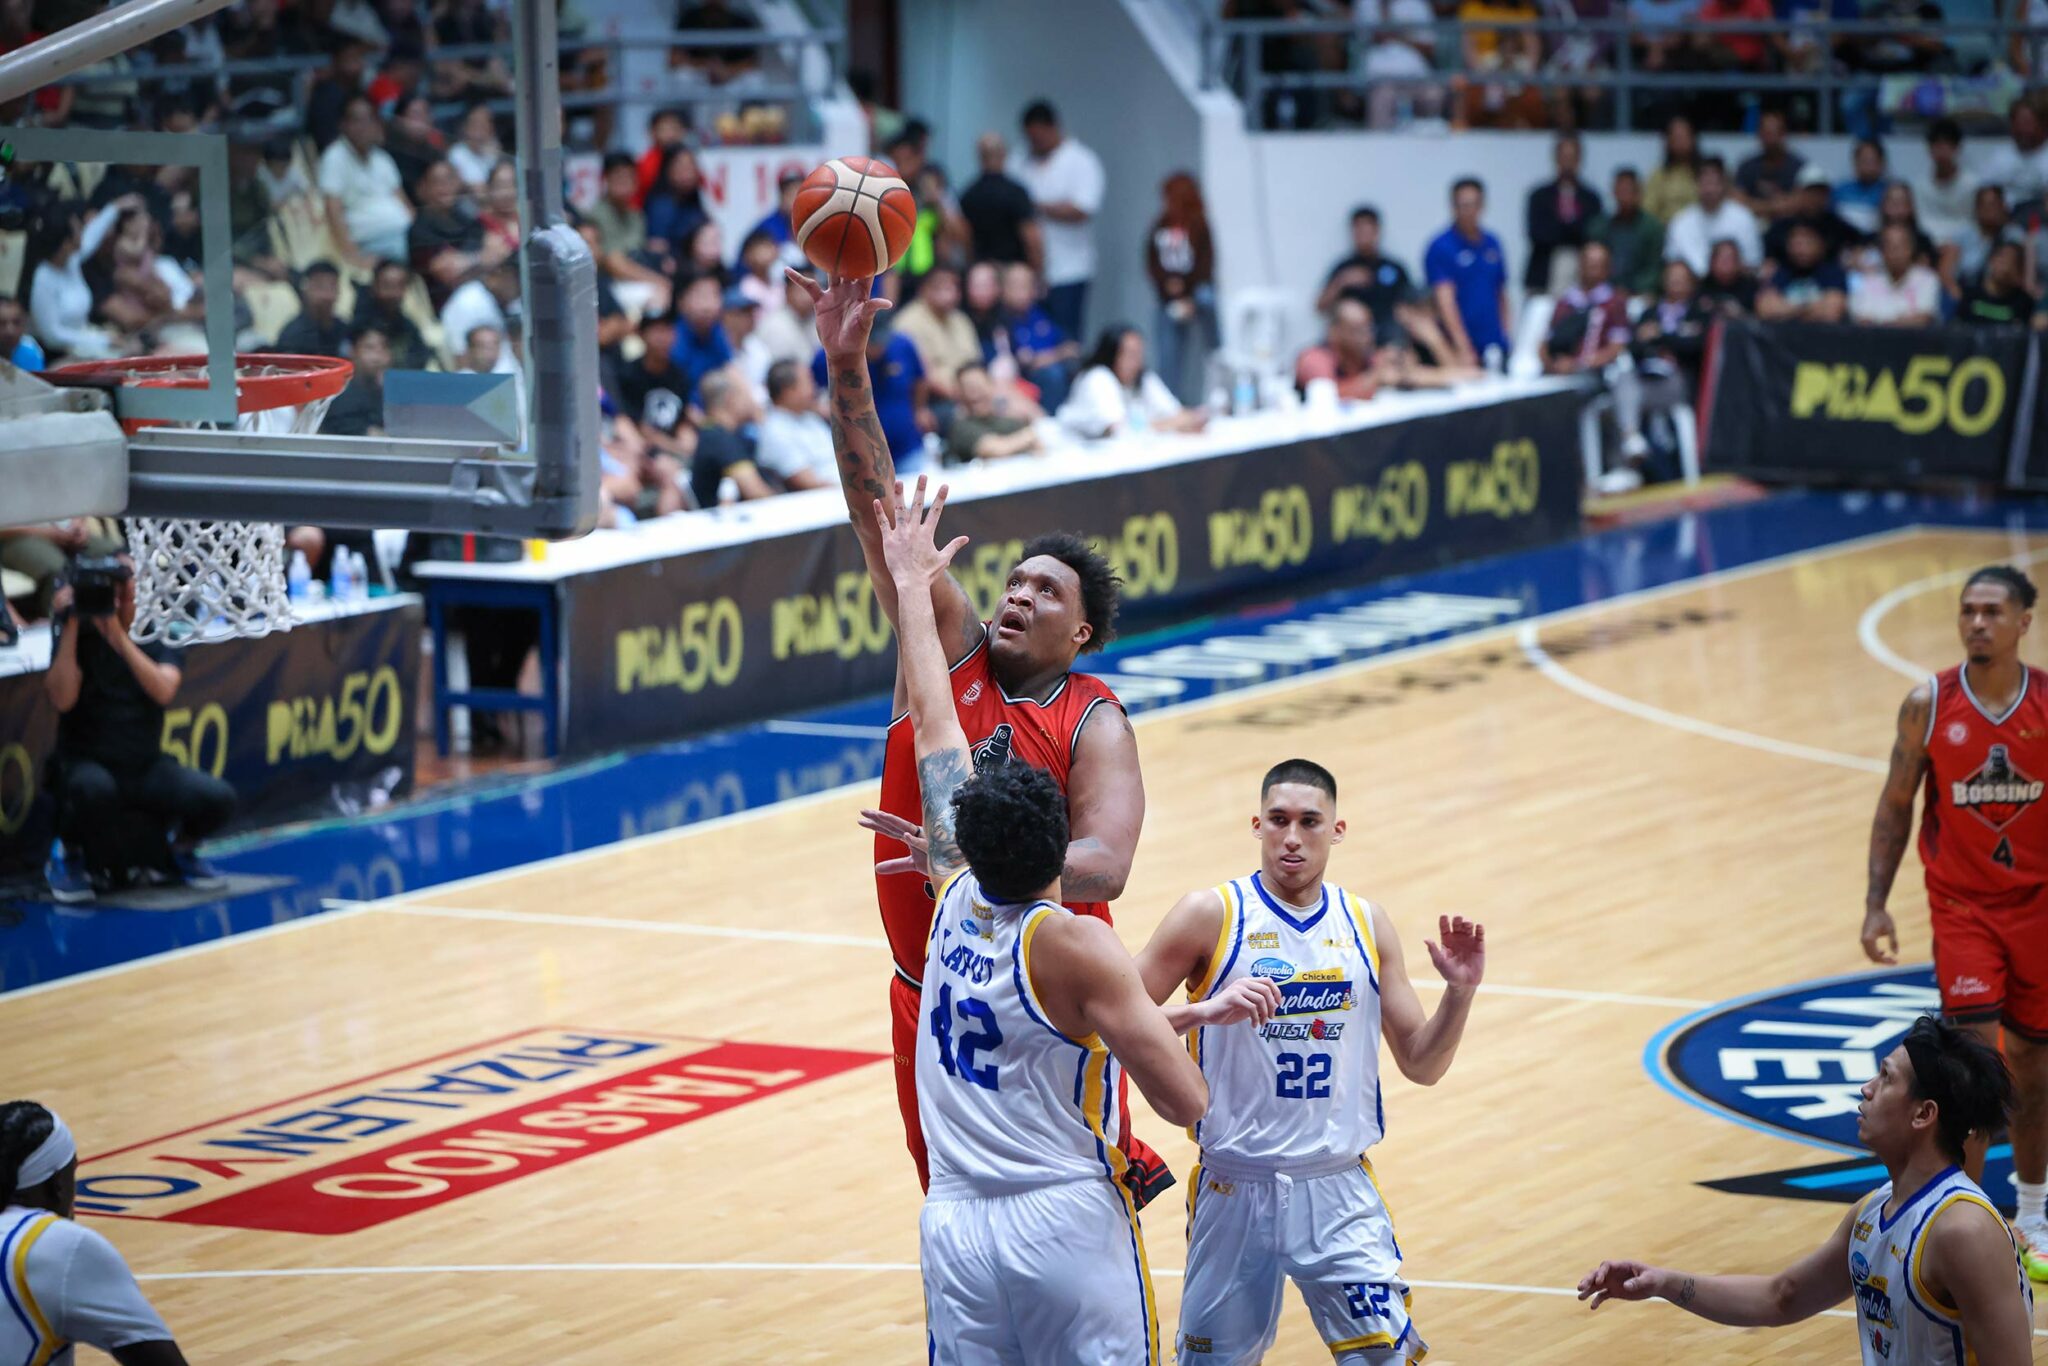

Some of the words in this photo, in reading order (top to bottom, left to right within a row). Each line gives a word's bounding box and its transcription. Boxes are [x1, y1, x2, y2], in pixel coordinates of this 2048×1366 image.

[1991, 834, 2015, 870] 4
[1248, 932, 1278, 941] GAME
[1249, 940, 1280, 949] VILLE
[940, 928, 995, 987] LAPUT
[1250, 963, 1294, 978] Magnolia
[1302, 973, 1337, 981] Chicken
[930, 982, 1003, 1091] 42
[1276, 1052, 1332, 1099] 22
[519, 1064, 806, 1134] TAAS
[312, 1129, 588, 1199] NOO
[1342, 1282, 1390, 1320] 22
